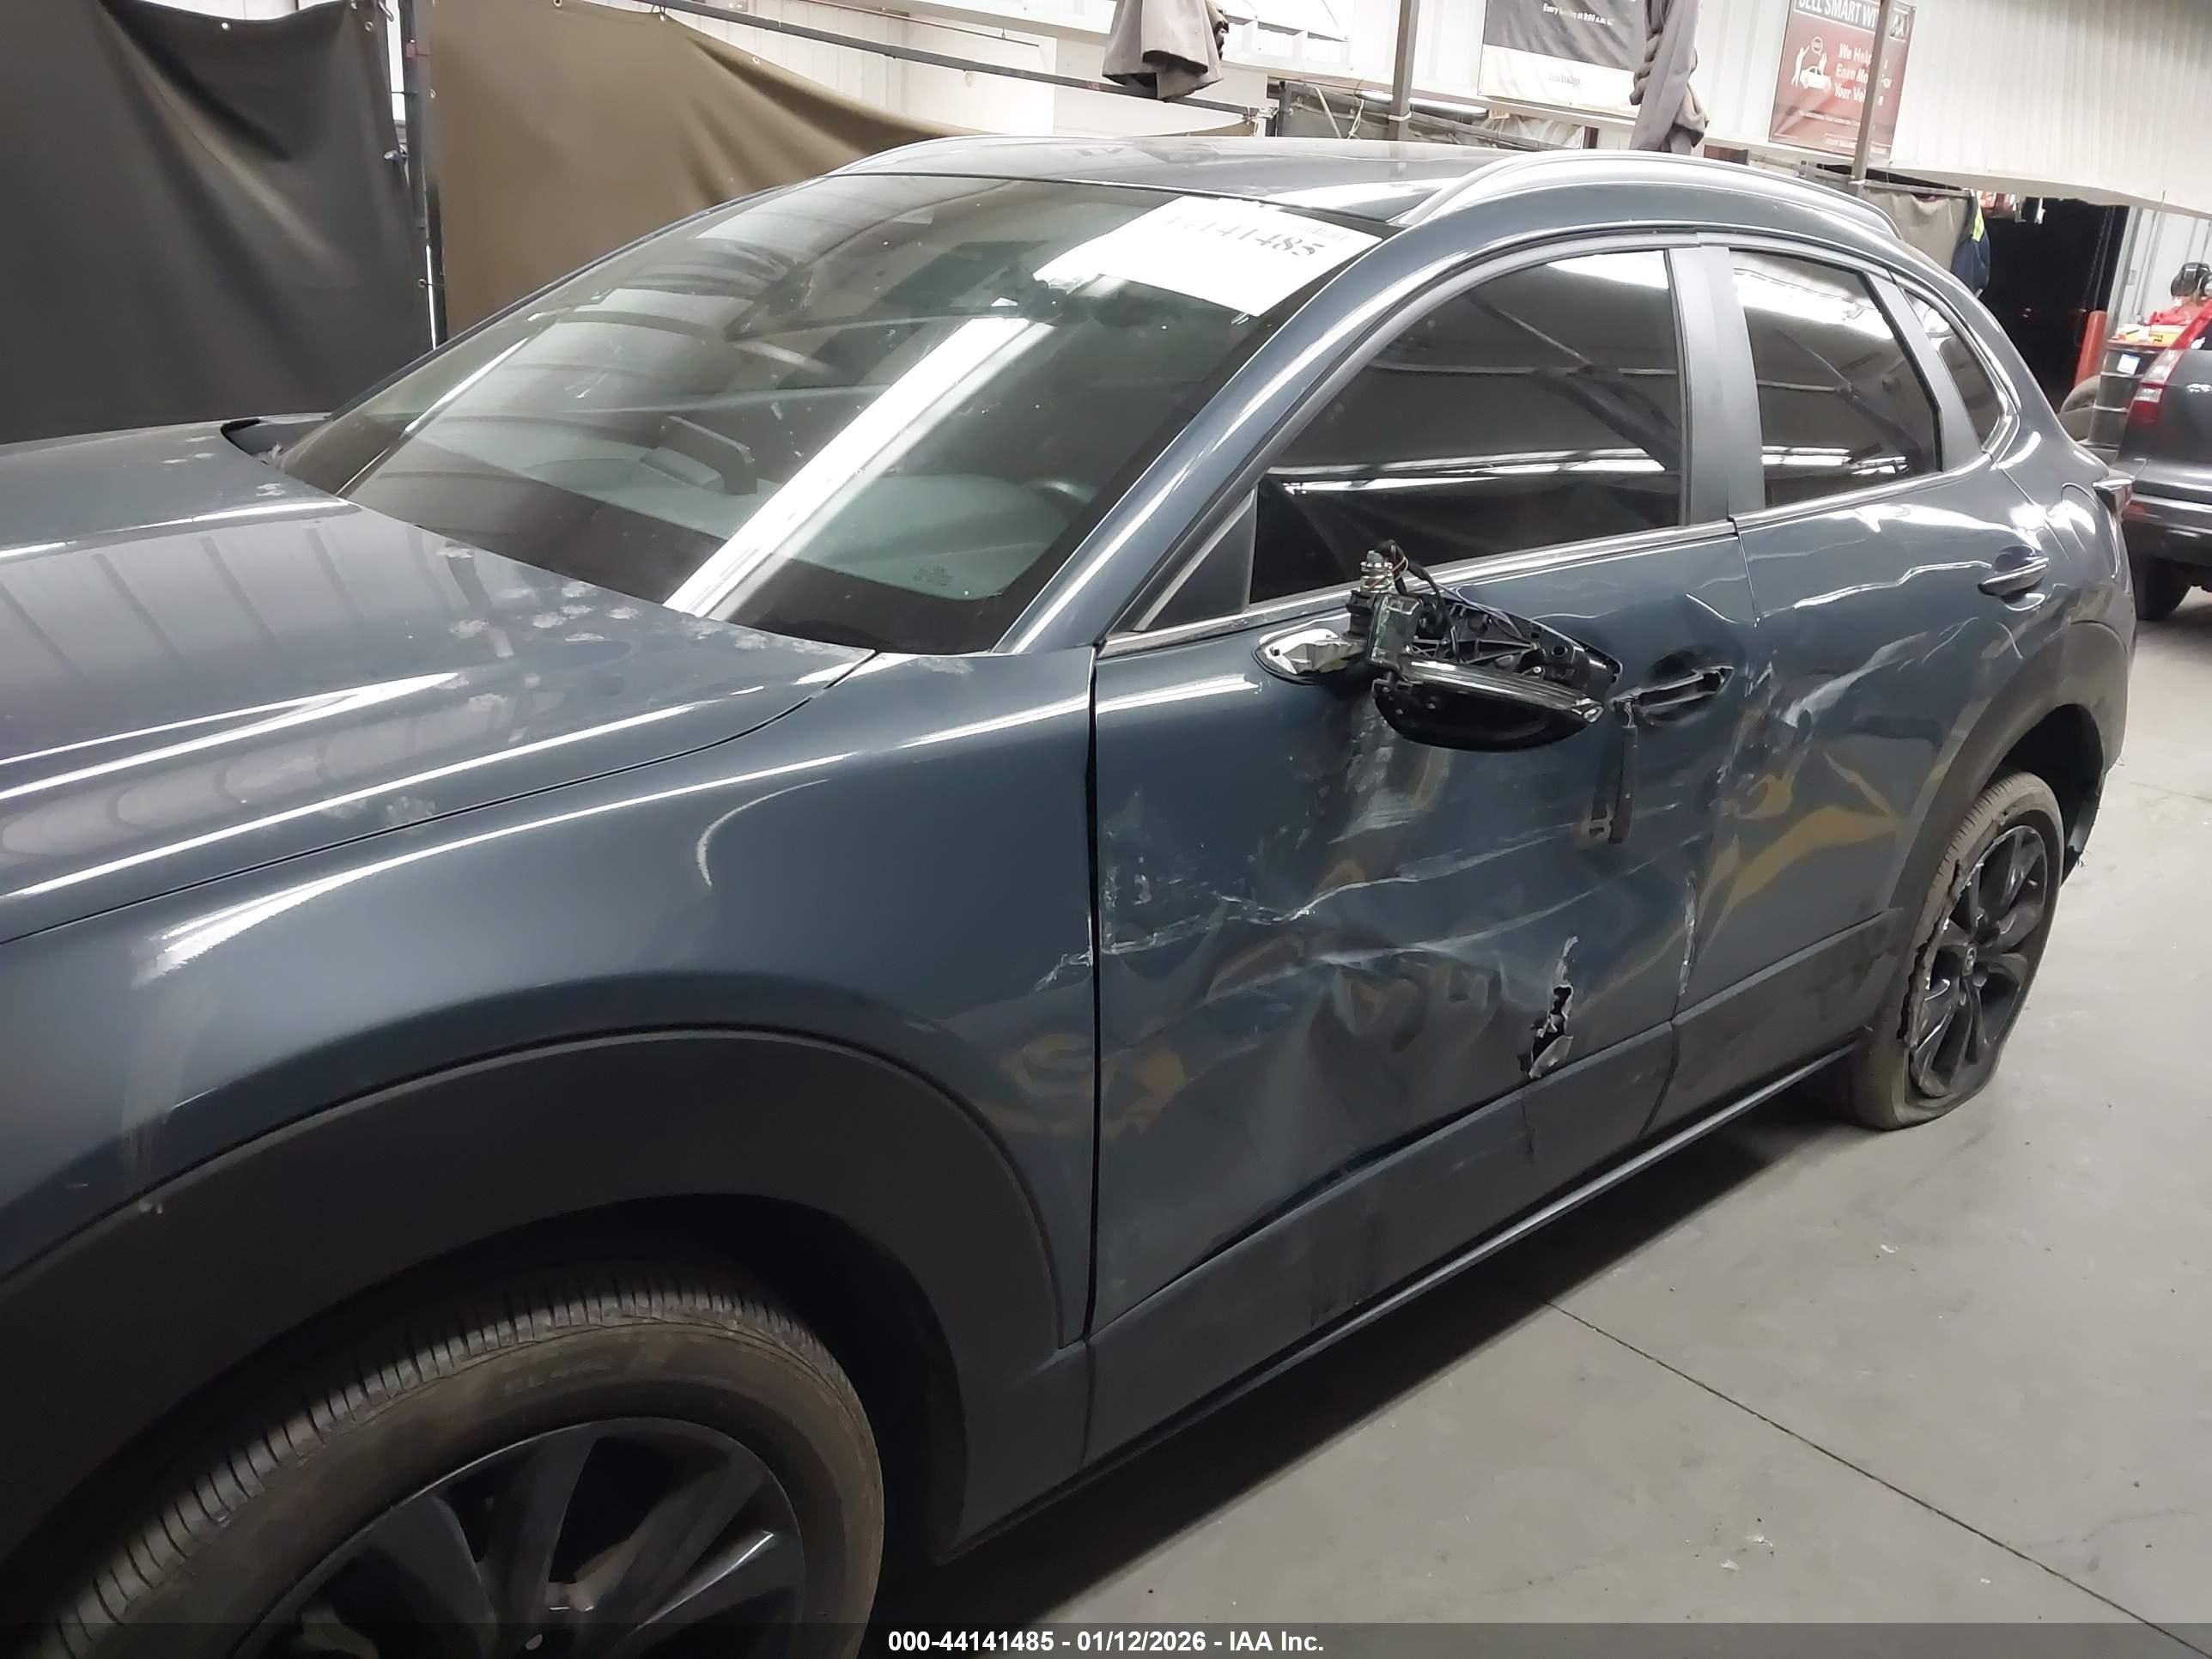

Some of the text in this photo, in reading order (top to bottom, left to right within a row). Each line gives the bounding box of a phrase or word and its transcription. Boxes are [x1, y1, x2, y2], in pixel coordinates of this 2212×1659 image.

[1824, 0, 1862, 23] SMART
[1838, 43, 1852, 59] We
[1834, 82, 1851, 100] Your
